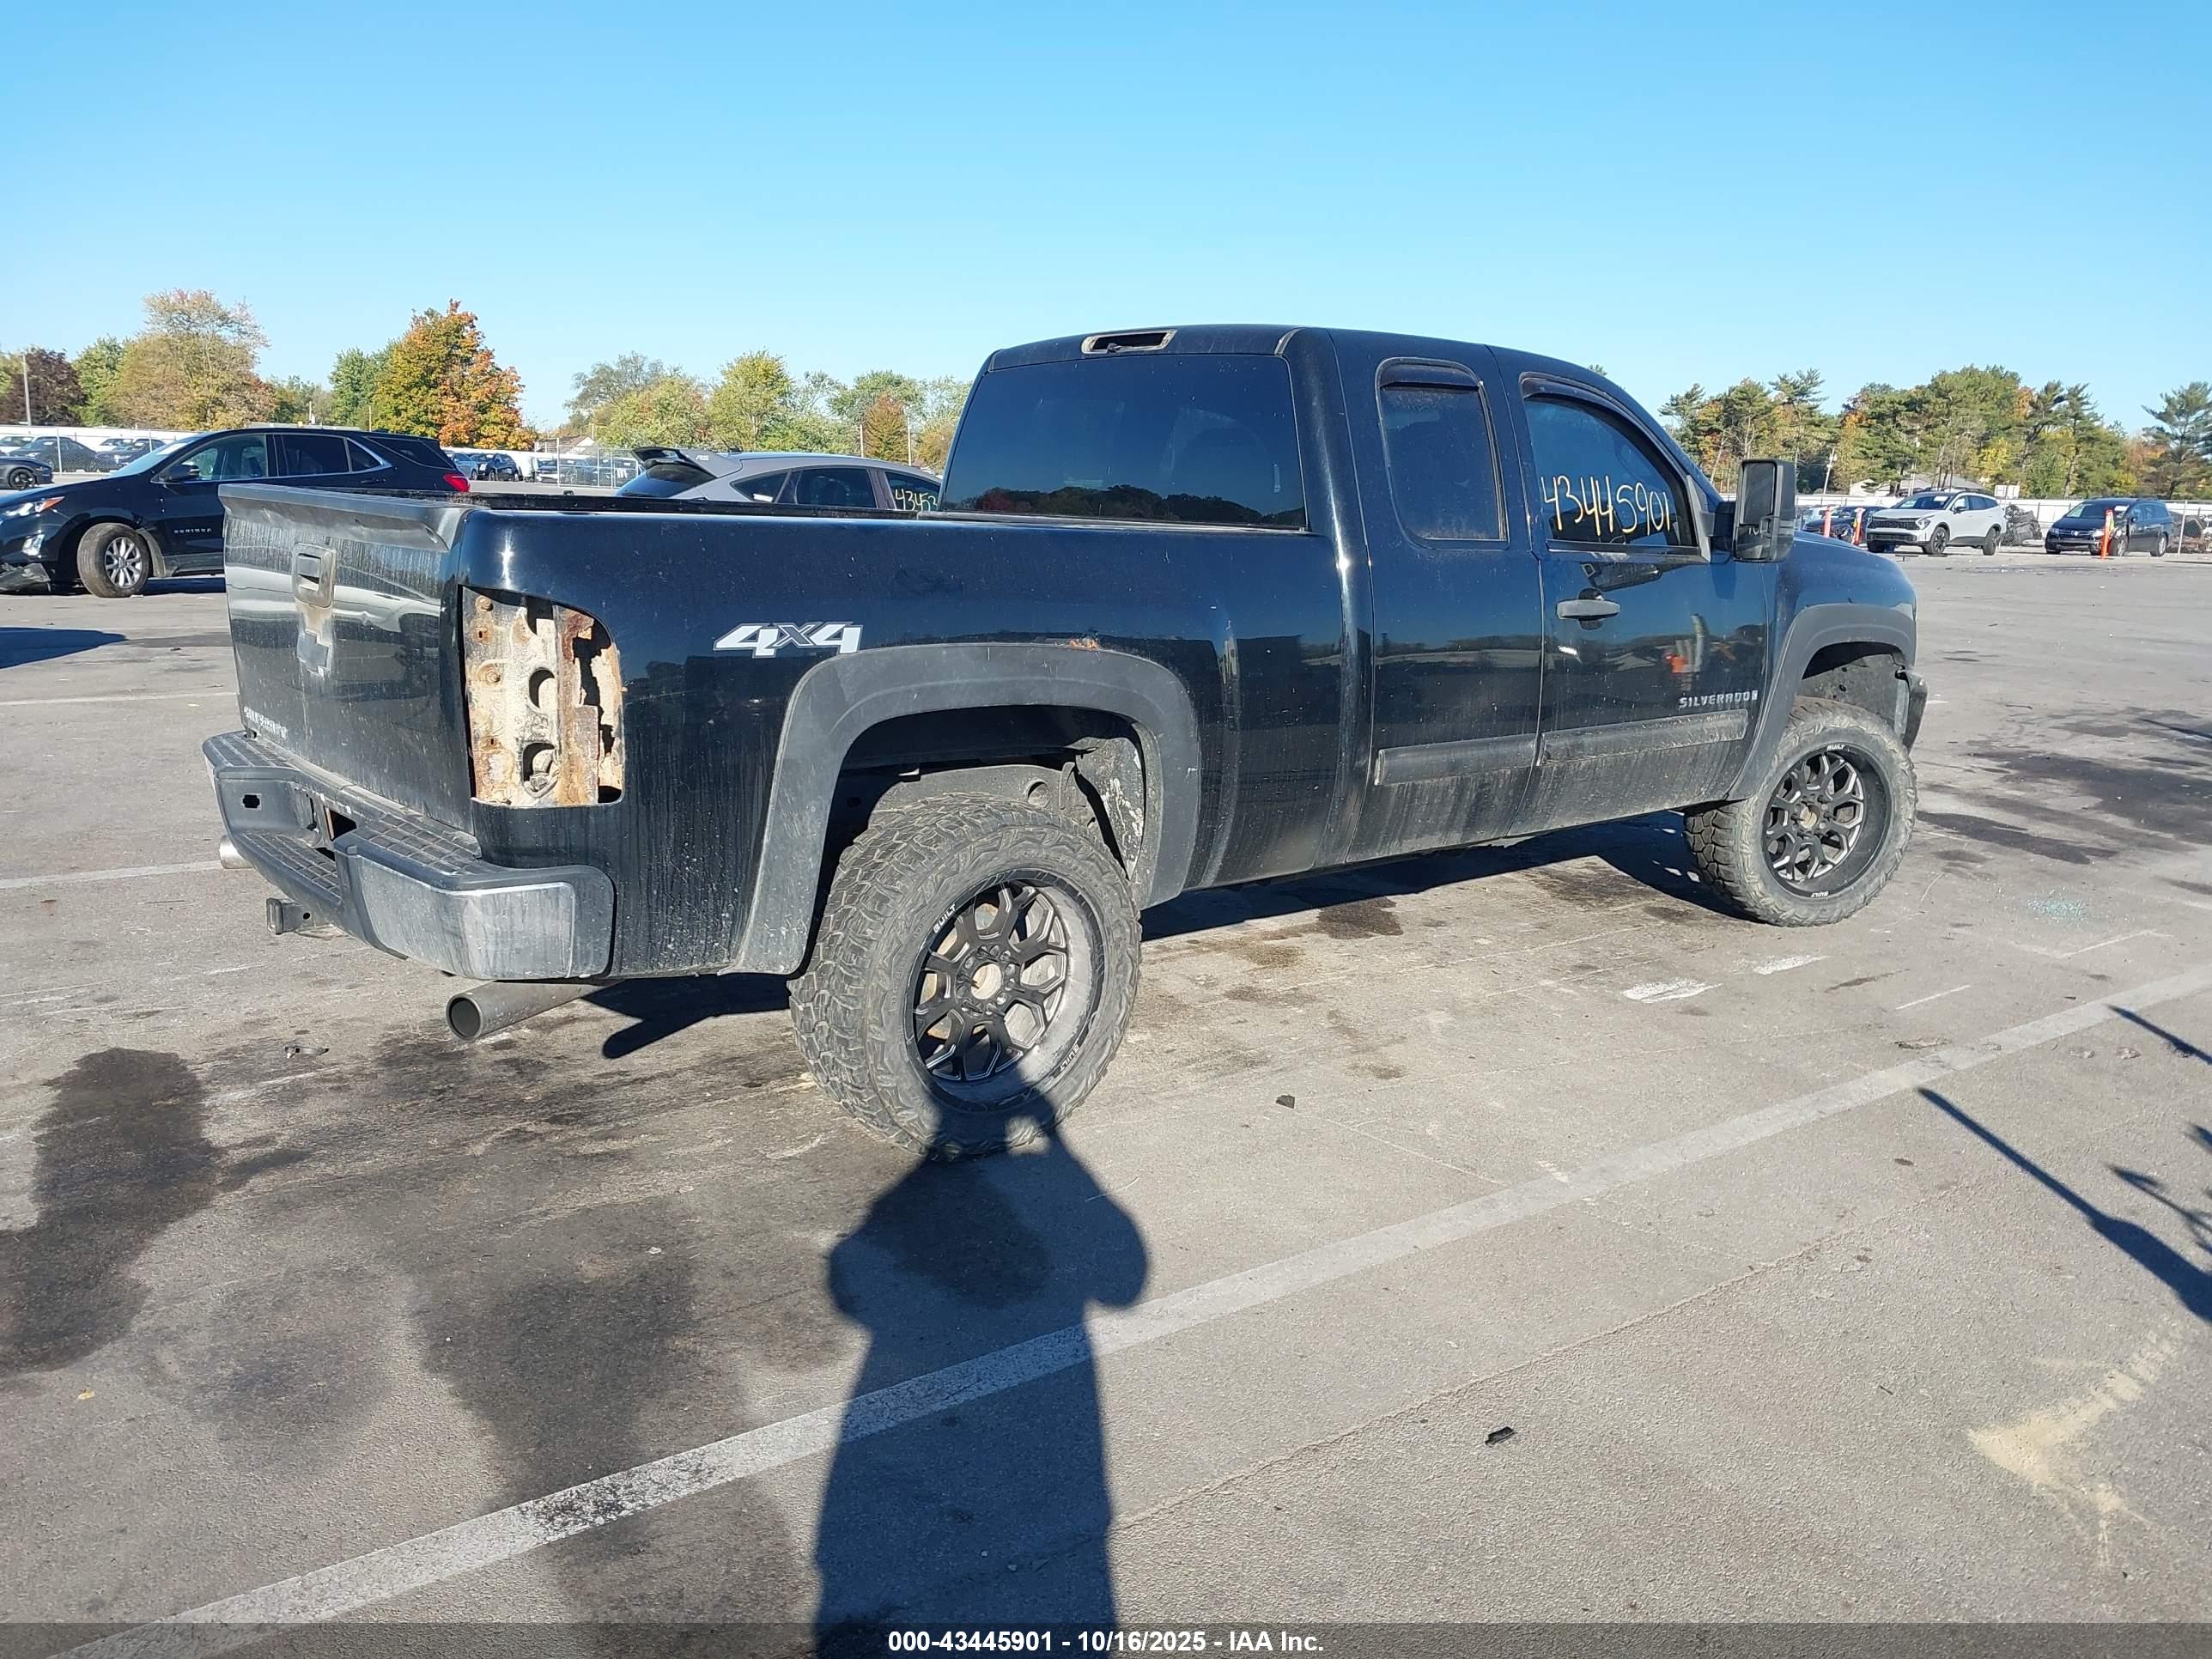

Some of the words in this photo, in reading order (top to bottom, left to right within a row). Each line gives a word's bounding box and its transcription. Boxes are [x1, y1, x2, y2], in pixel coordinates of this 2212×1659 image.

[1540, 475, 1670, 537] 43445901
[1679, 690, 1750, 708] SILVERADO
[933, 903, 956, 933] BUILT
